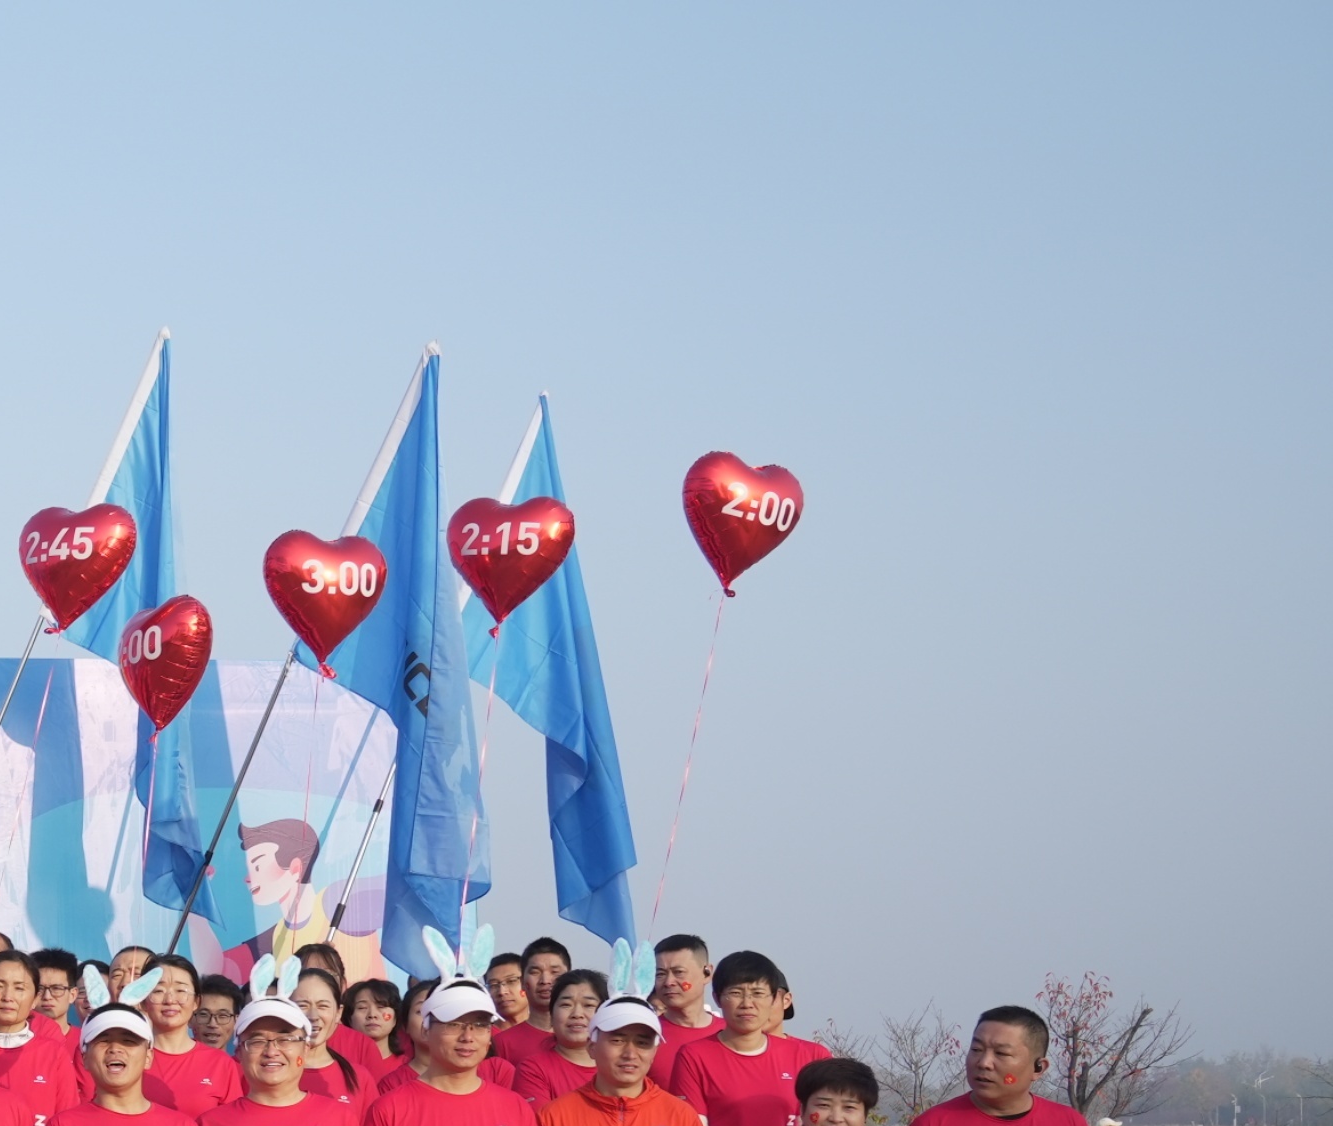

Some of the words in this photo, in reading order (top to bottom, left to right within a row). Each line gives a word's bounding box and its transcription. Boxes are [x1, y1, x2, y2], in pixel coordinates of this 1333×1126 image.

[721, 482, 795, 532] 2:00
[25, 526, 95, 565] 2:45
[460, 522, 540, 556] 2:15
[301, 558, 377, 597] 3:00
